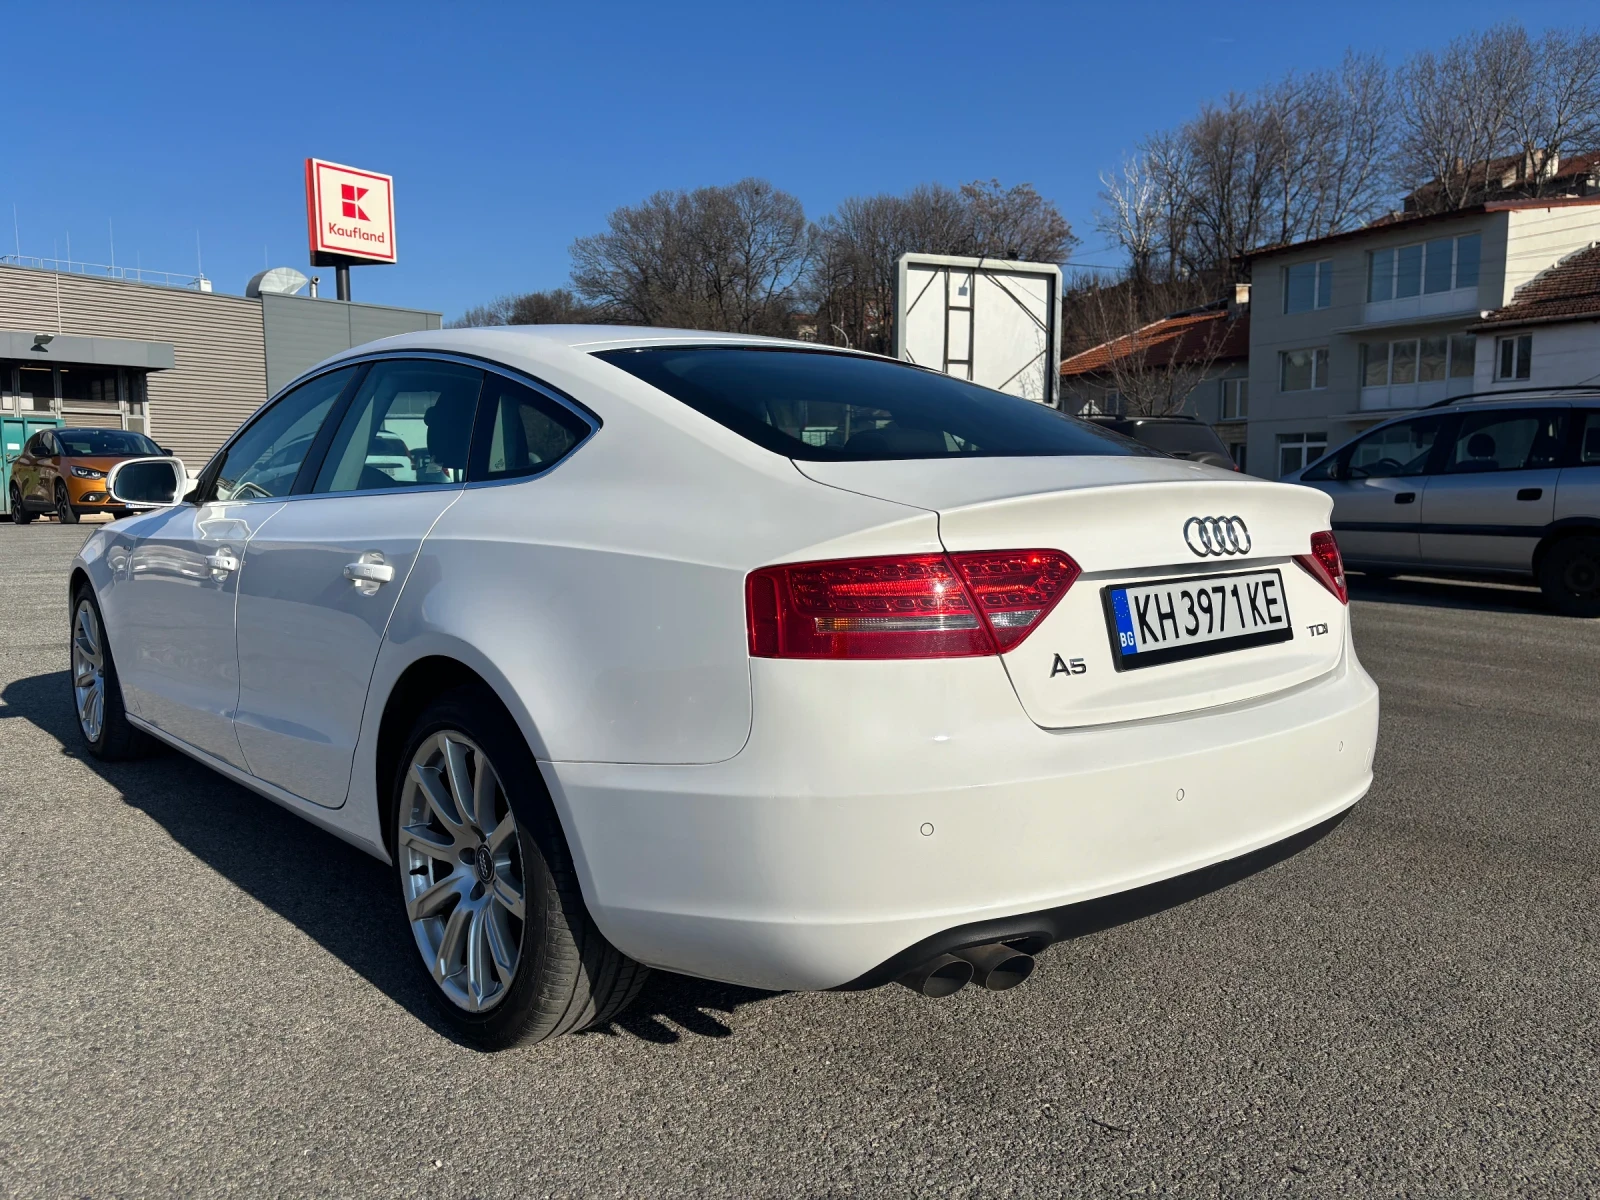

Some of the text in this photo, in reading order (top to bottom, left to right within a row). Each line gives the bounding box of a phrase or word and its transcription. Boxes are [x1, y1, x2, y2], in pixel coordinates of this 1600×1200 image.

[328, 222, 385, 243] Kaufland
[1134, 579, 1283, 645] KH3971KE
[1119, 631, 1135, 648] BG
[1306, 622, 1329, 638] TDI
[1049, 652, 1087, 678] A5
